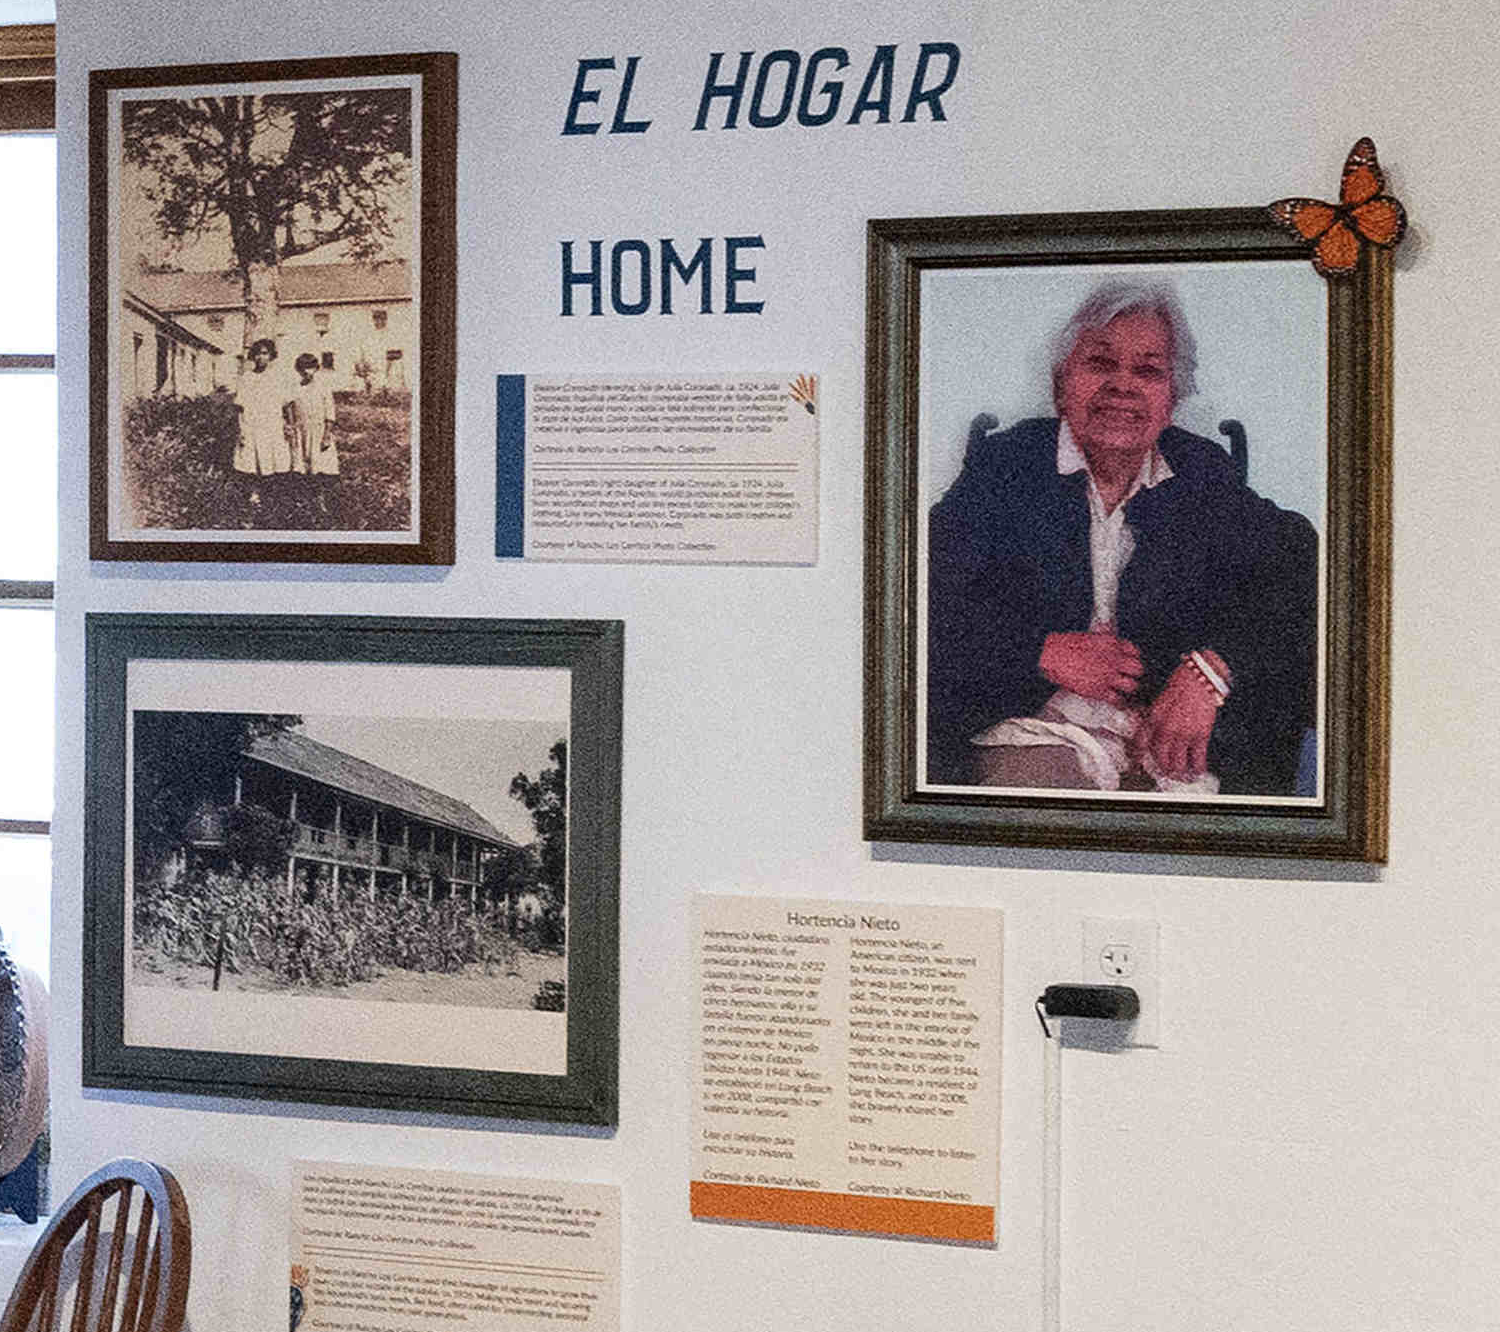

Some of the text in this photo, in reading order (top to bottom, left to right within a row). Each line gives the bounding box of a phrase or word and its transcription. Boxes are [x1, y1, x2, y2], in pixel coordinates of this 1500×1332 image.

[561, 41, 962, 136] EL HOGAR
[560, 235, 766, 317] HOME
[787, 911, 901, 933] Hortencia Nieto
